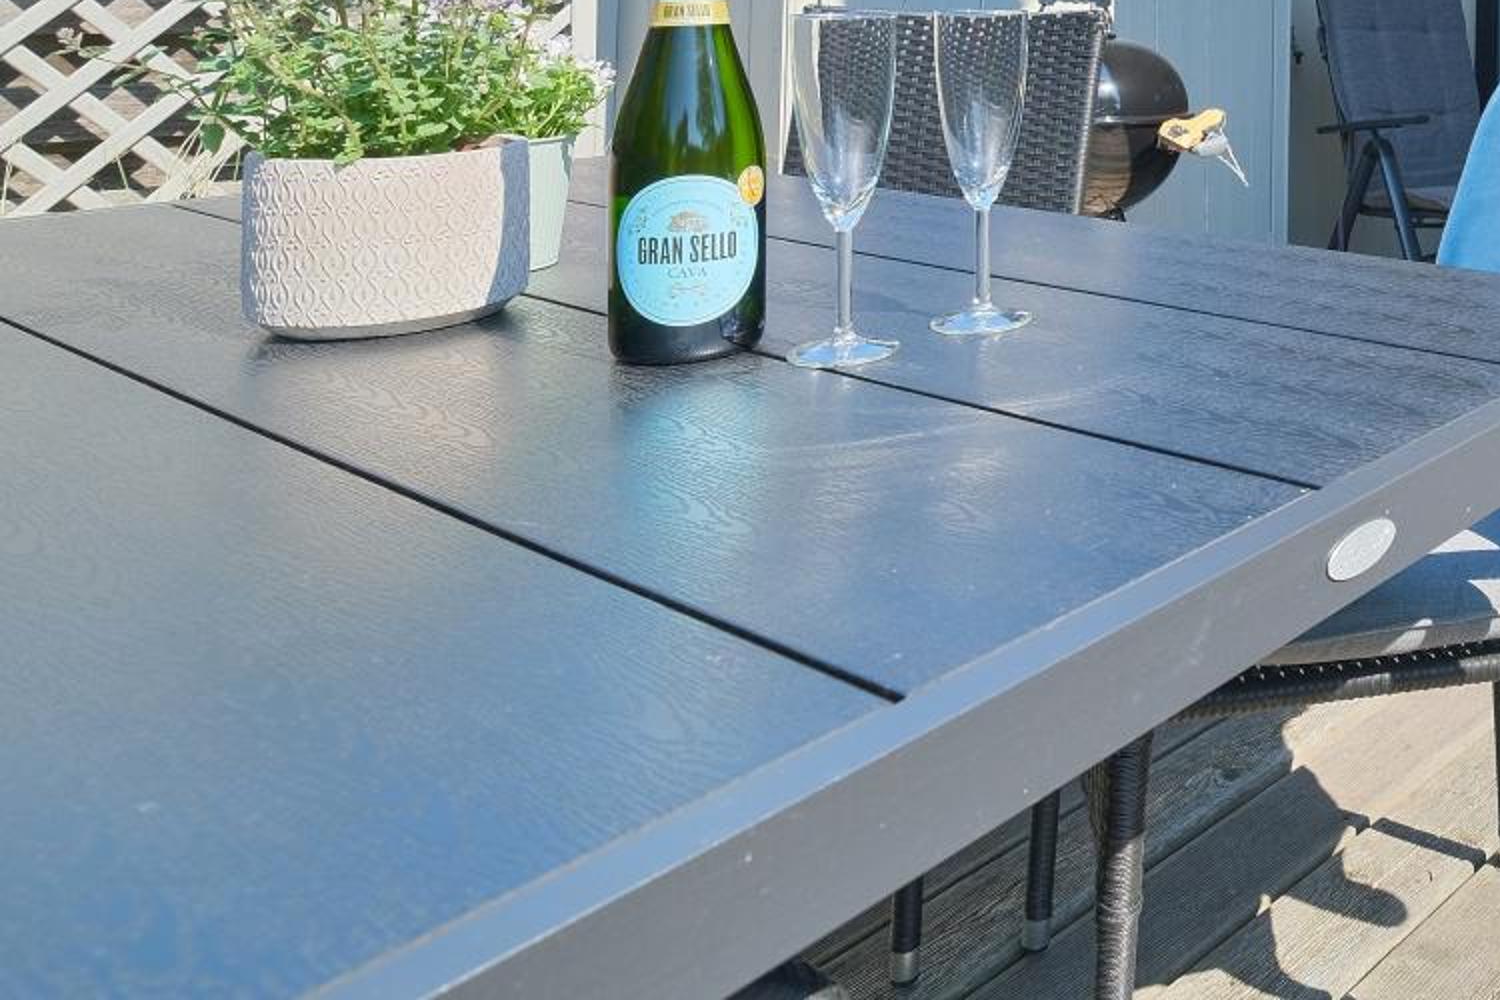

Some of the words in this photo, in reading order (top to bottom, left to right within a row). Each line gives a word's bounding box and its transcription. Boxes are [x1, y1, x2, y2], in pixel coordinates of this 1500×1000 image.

[638, 236, 683, 265] GRAN
[690, 231, 737, 262] SELLO
[667, 266, 708, 278] CAVA
